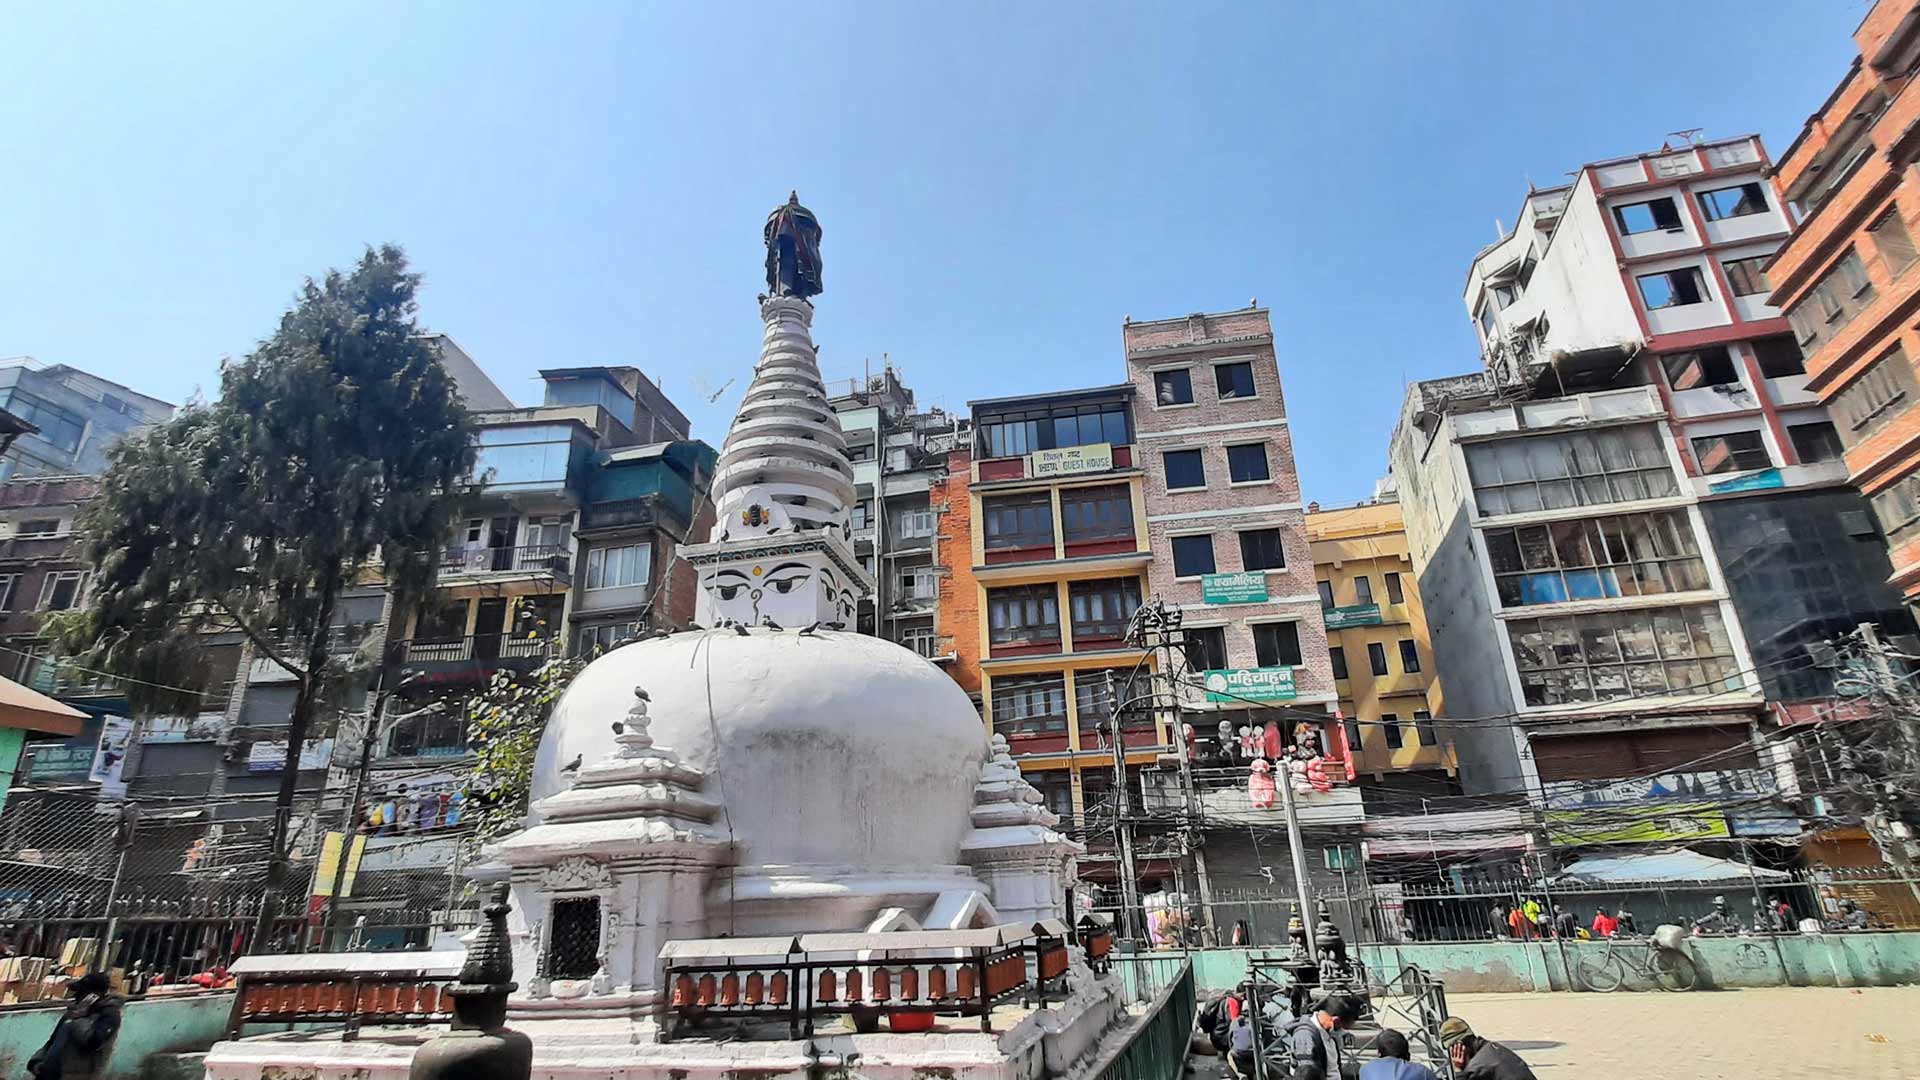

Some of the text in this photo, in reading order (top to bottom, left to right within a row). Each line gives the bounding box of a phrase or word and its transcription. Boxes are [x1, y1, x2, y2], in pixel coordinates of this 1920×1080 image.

[1063, 459, 1084, 470] GUEST
[1086, 457, 1110, 468] HOUSE
[1214, 573, 1265, 586] क्यामेलिया
